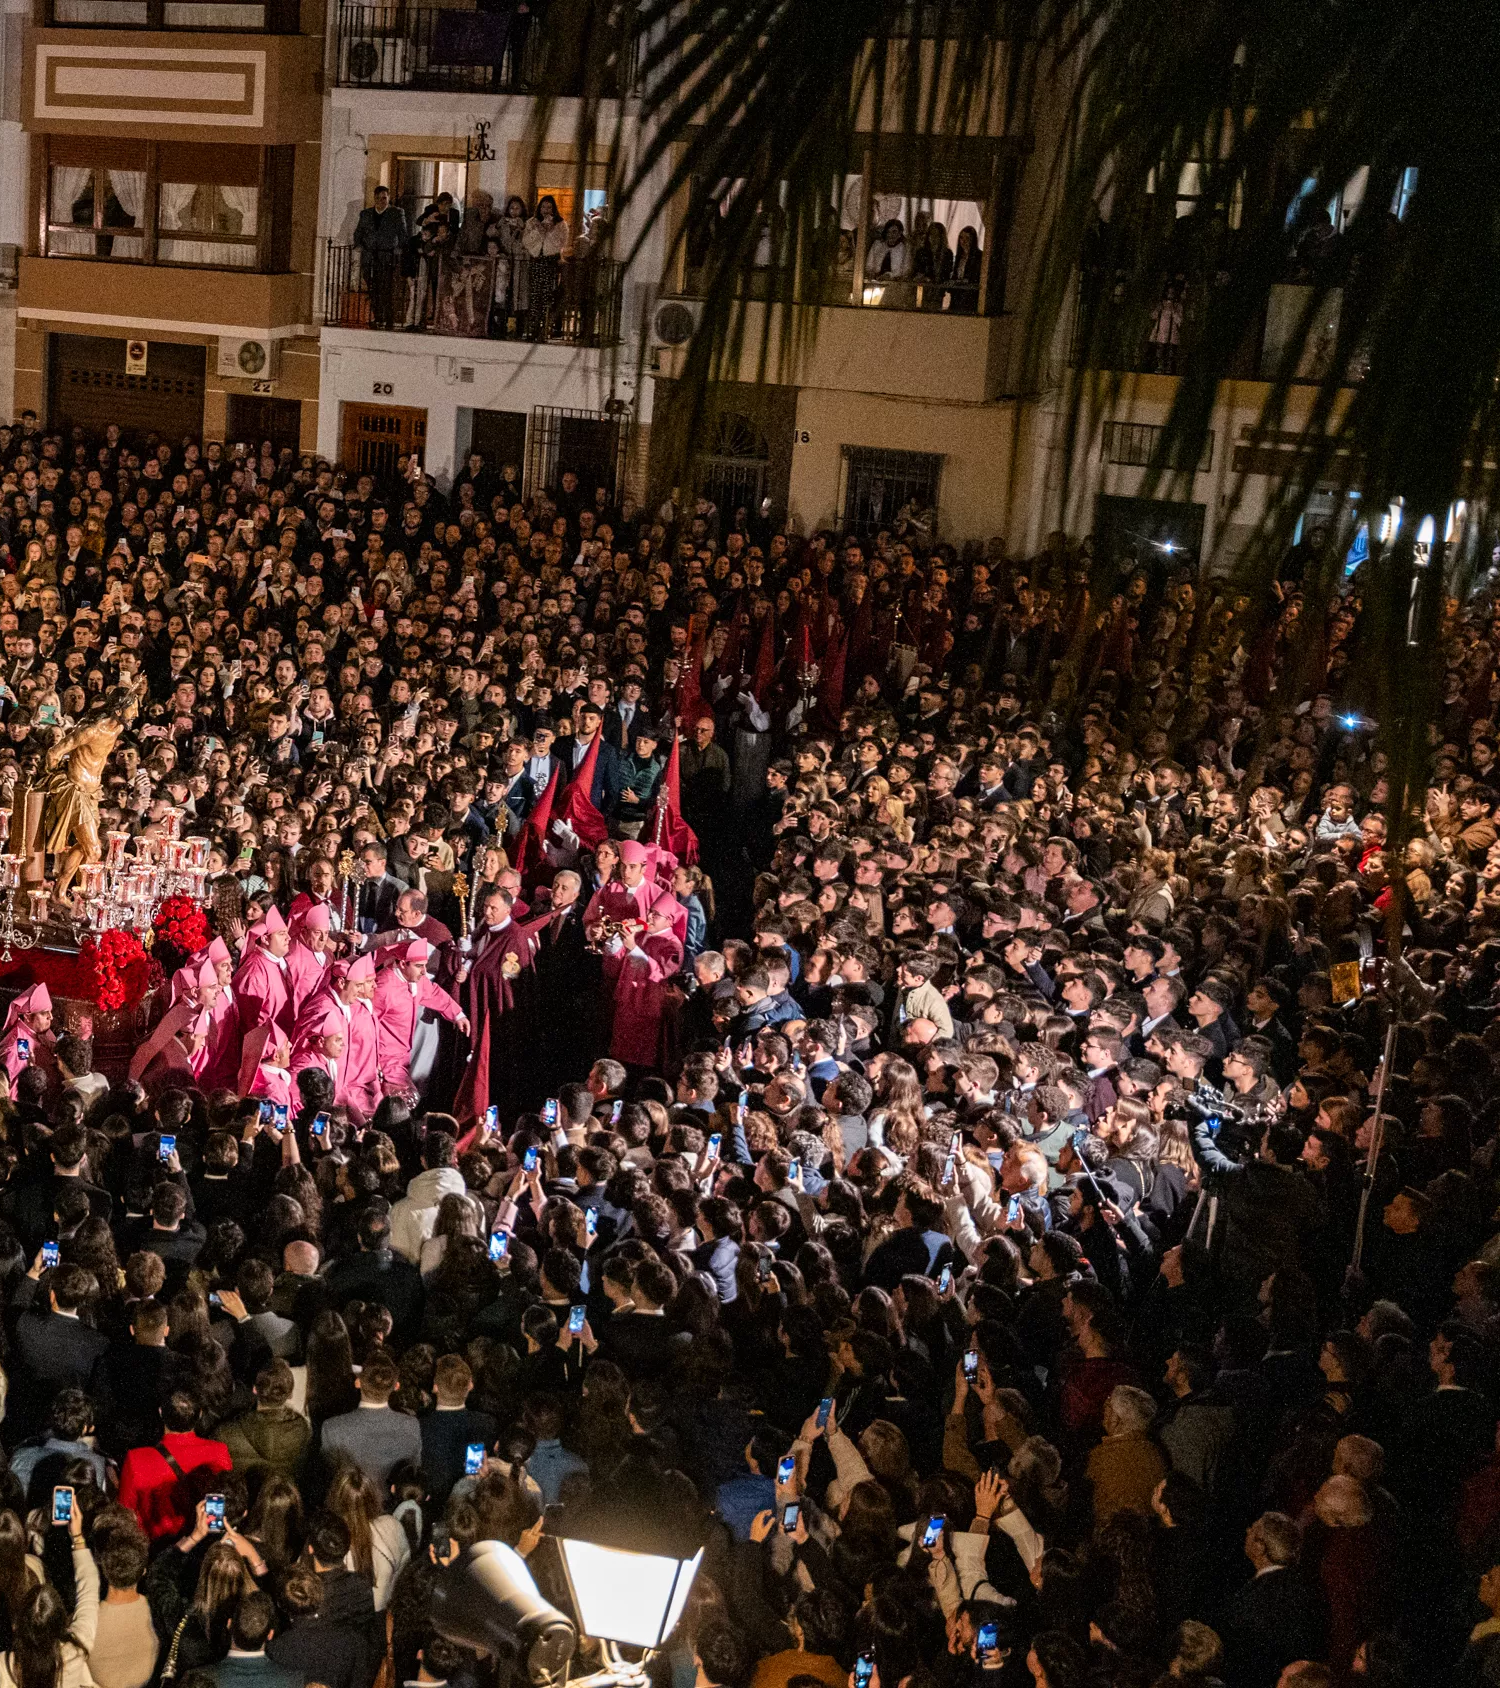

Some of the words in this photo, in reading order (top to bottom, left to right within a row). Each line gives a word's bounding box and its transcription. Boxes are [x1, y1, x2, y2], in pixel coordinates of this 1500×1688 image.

[253, 381, 270, 393] 22
[373, 382, 392, 395] 20
[795, 430, 810, 443] 18
